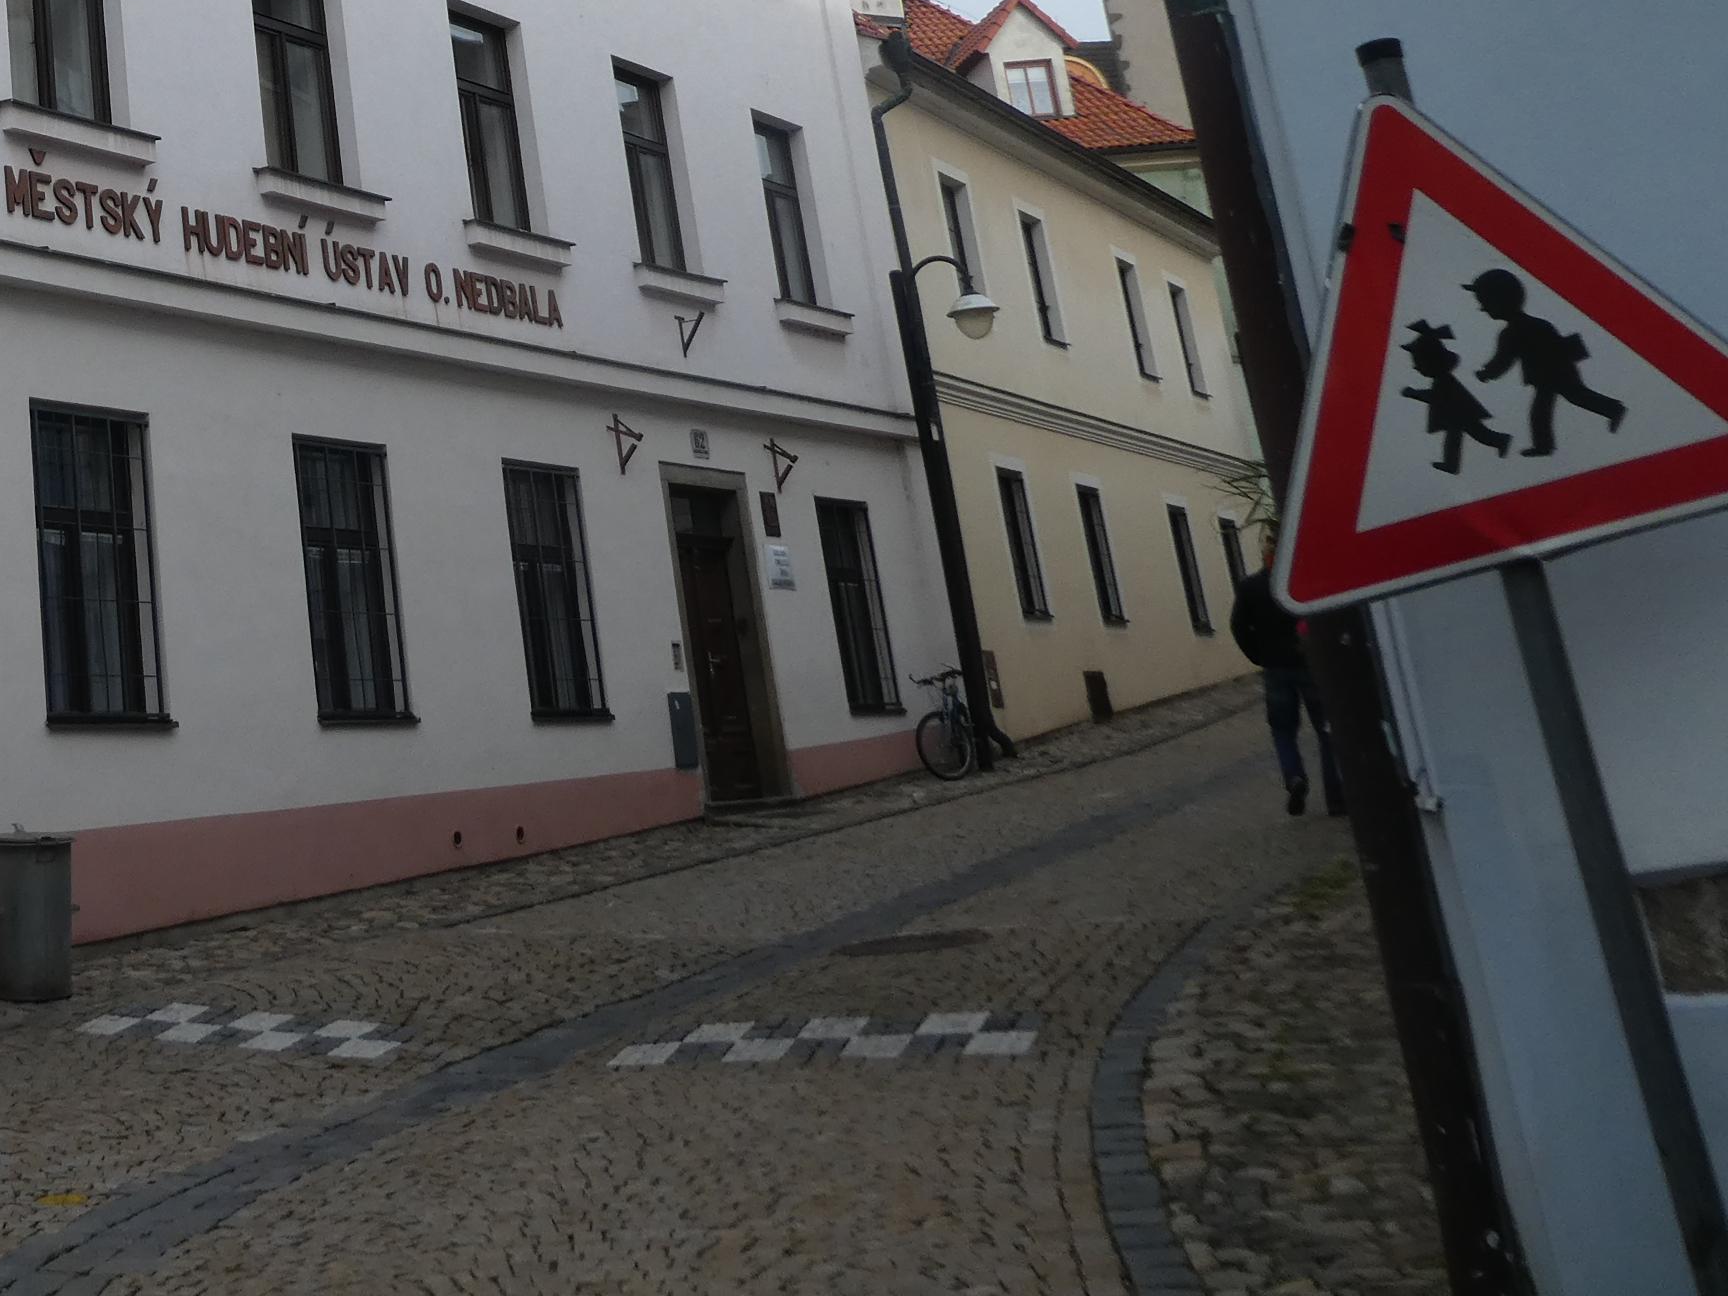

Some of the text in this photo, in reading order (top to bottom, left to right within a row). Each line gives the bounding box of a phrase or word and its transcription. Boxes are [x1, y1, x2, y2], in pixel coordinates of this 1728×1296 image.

[3, 148, 563, 329] MĚSTSKÝ HUDEBNÍ ÚSTAV O. NEDBALA
